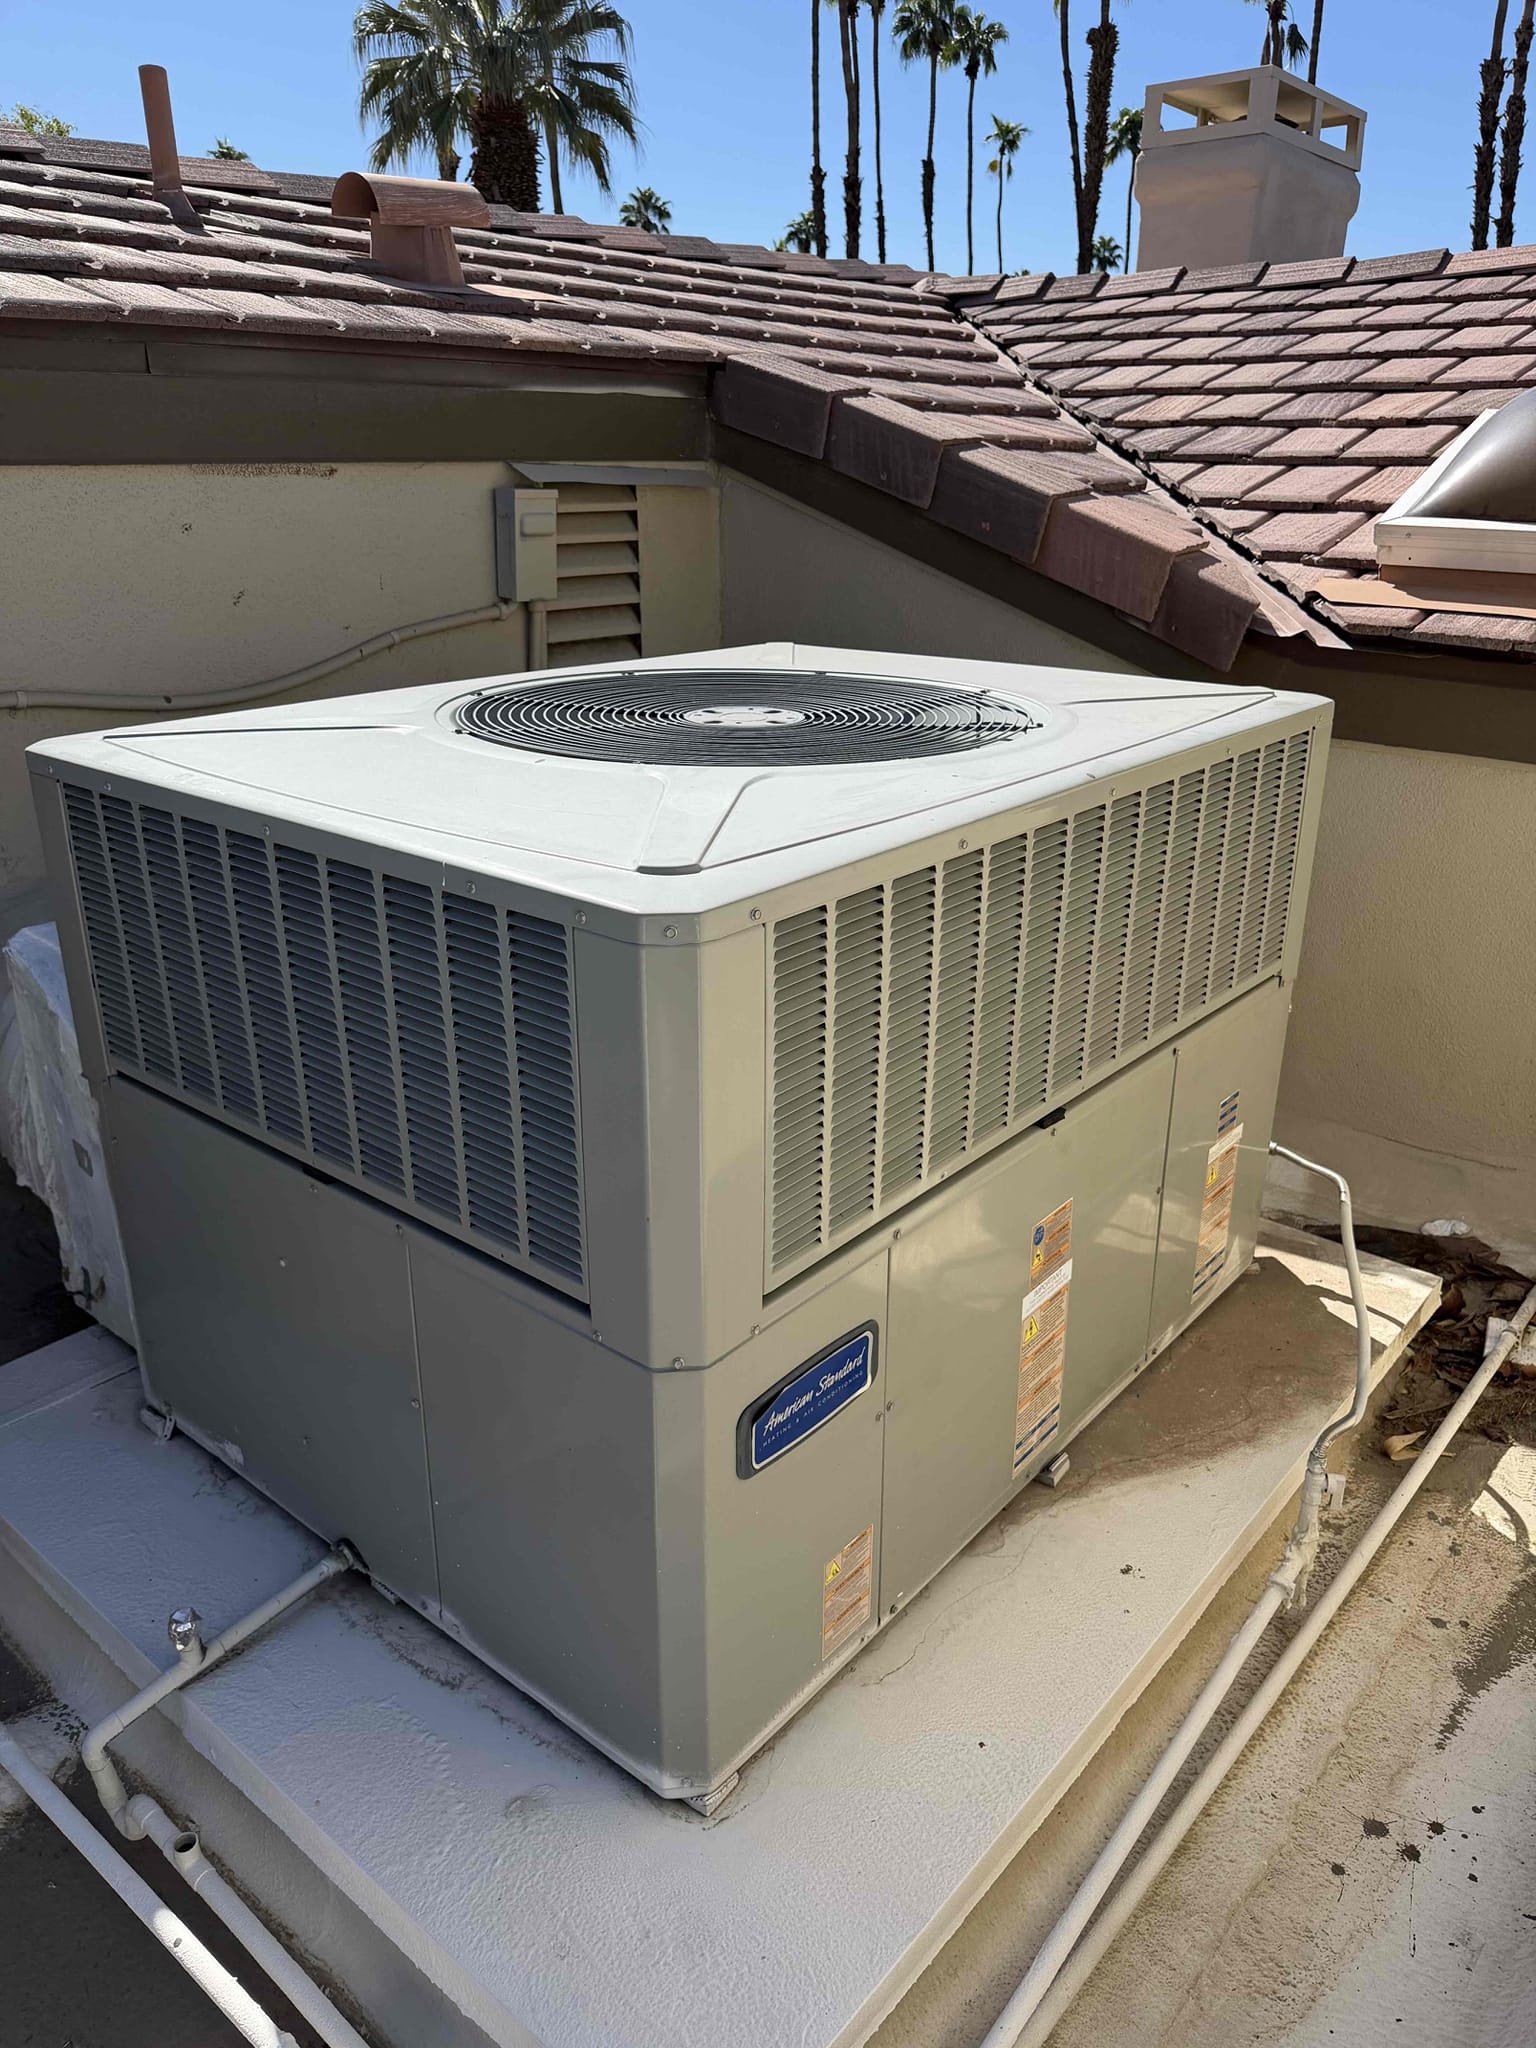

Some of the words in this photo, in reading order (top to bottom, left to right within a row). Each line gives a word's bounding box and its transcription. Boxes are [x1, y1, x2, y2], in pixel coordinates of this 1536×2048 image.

[1033, 1269, 1063, 1298] IMPORTANT
[763, 1389, 814, 1437] American
[815, 1346, 866, 1397] Standard
[763, 1423, 792, 1447] HEATING
[803, 1407, 814, 1418] AIR
[818, 1370, 864, 1406] CONDITIONING
